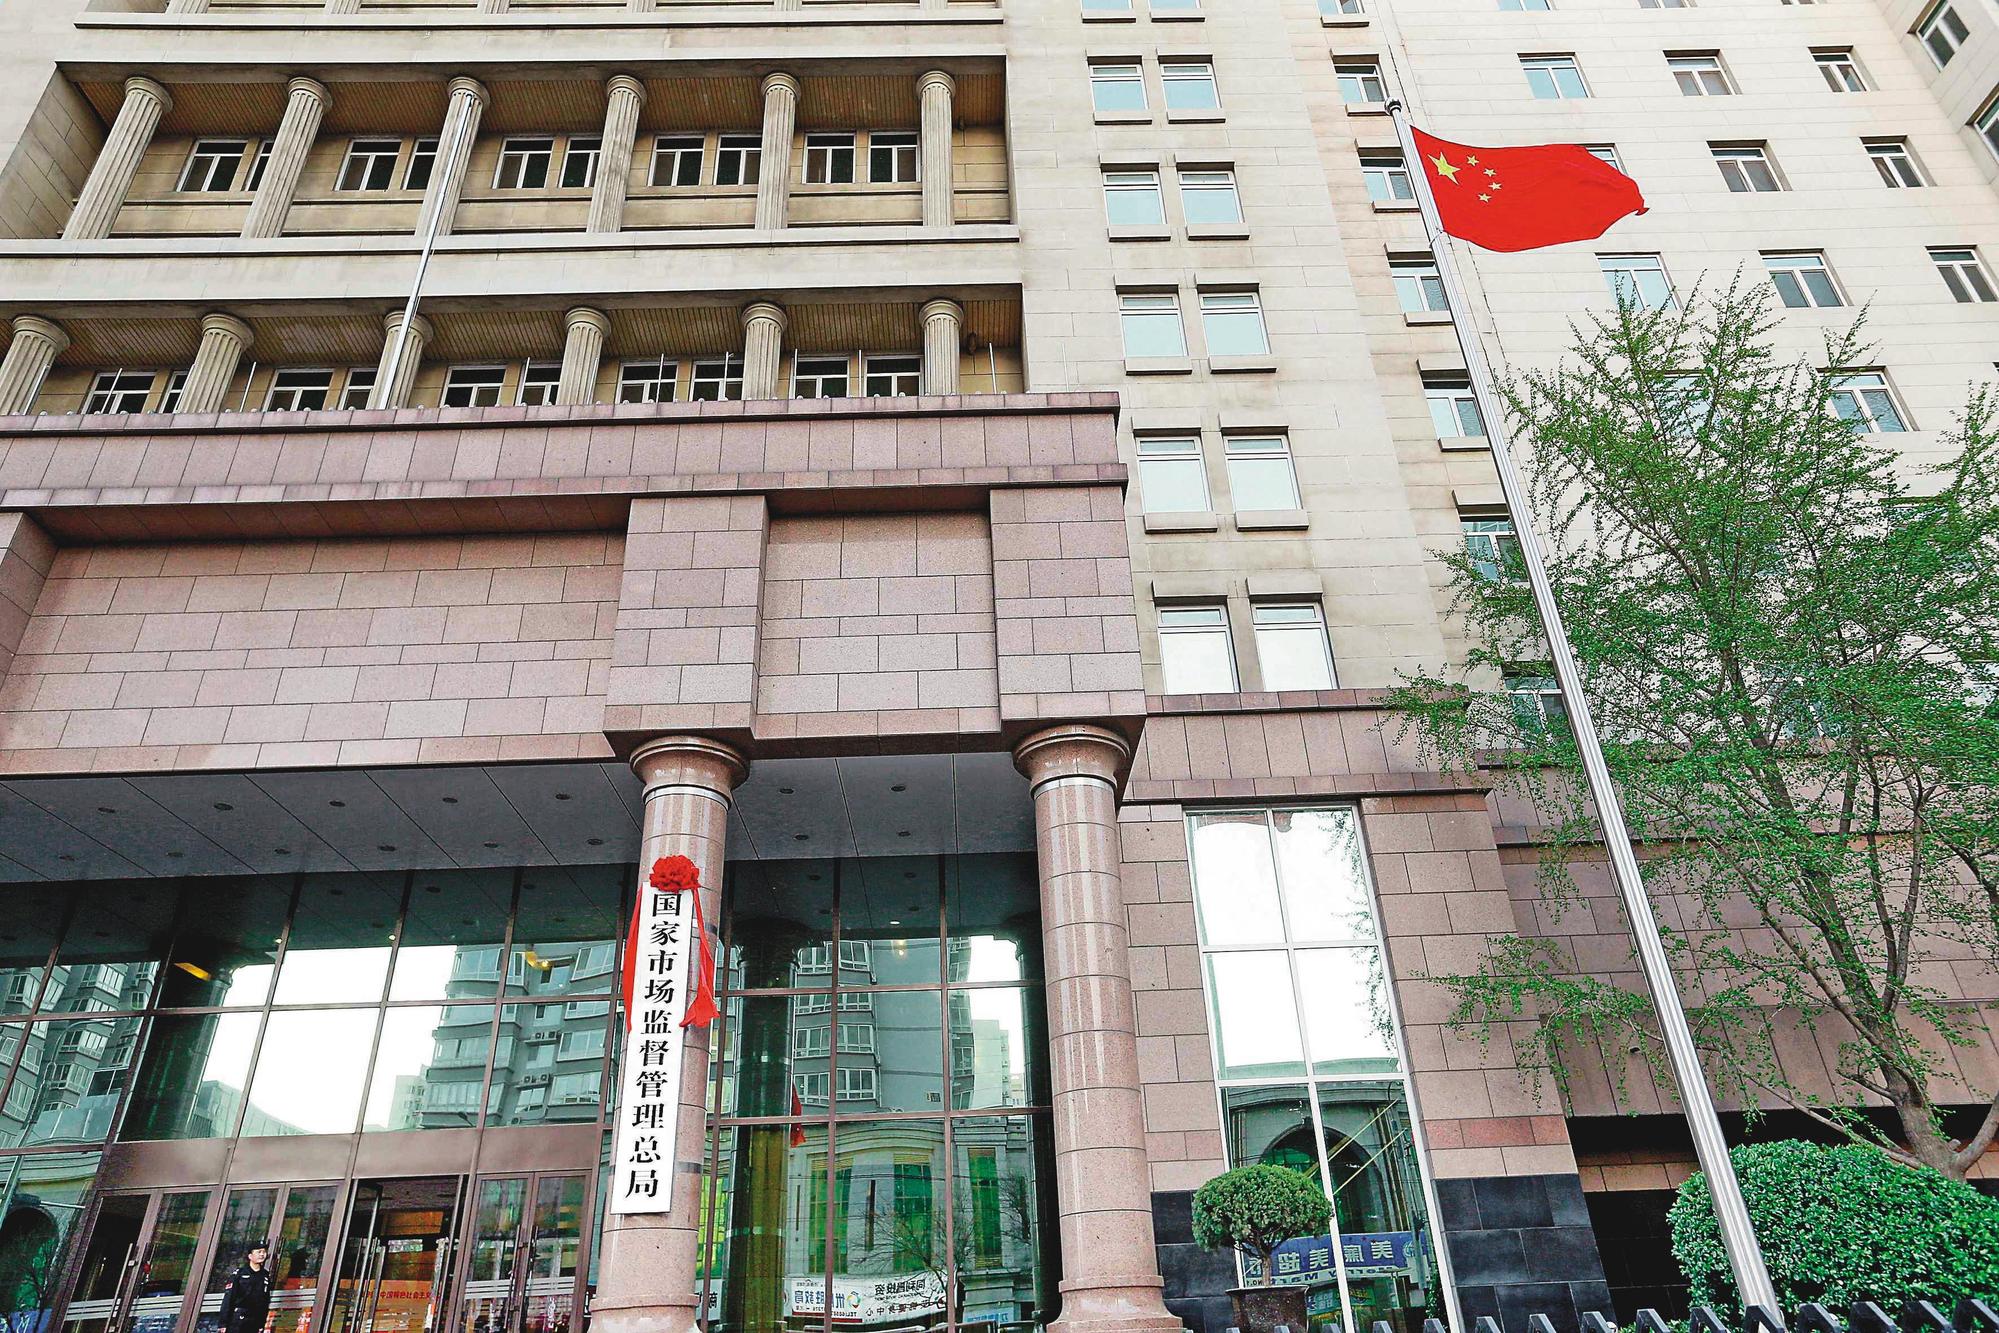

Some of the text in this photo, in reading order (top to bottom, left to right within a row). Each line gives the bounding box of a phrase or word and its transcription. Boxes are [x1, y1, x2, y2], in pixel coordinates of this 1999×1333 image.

[625, 892, 682, 1199] 国家市场监督管理总局
